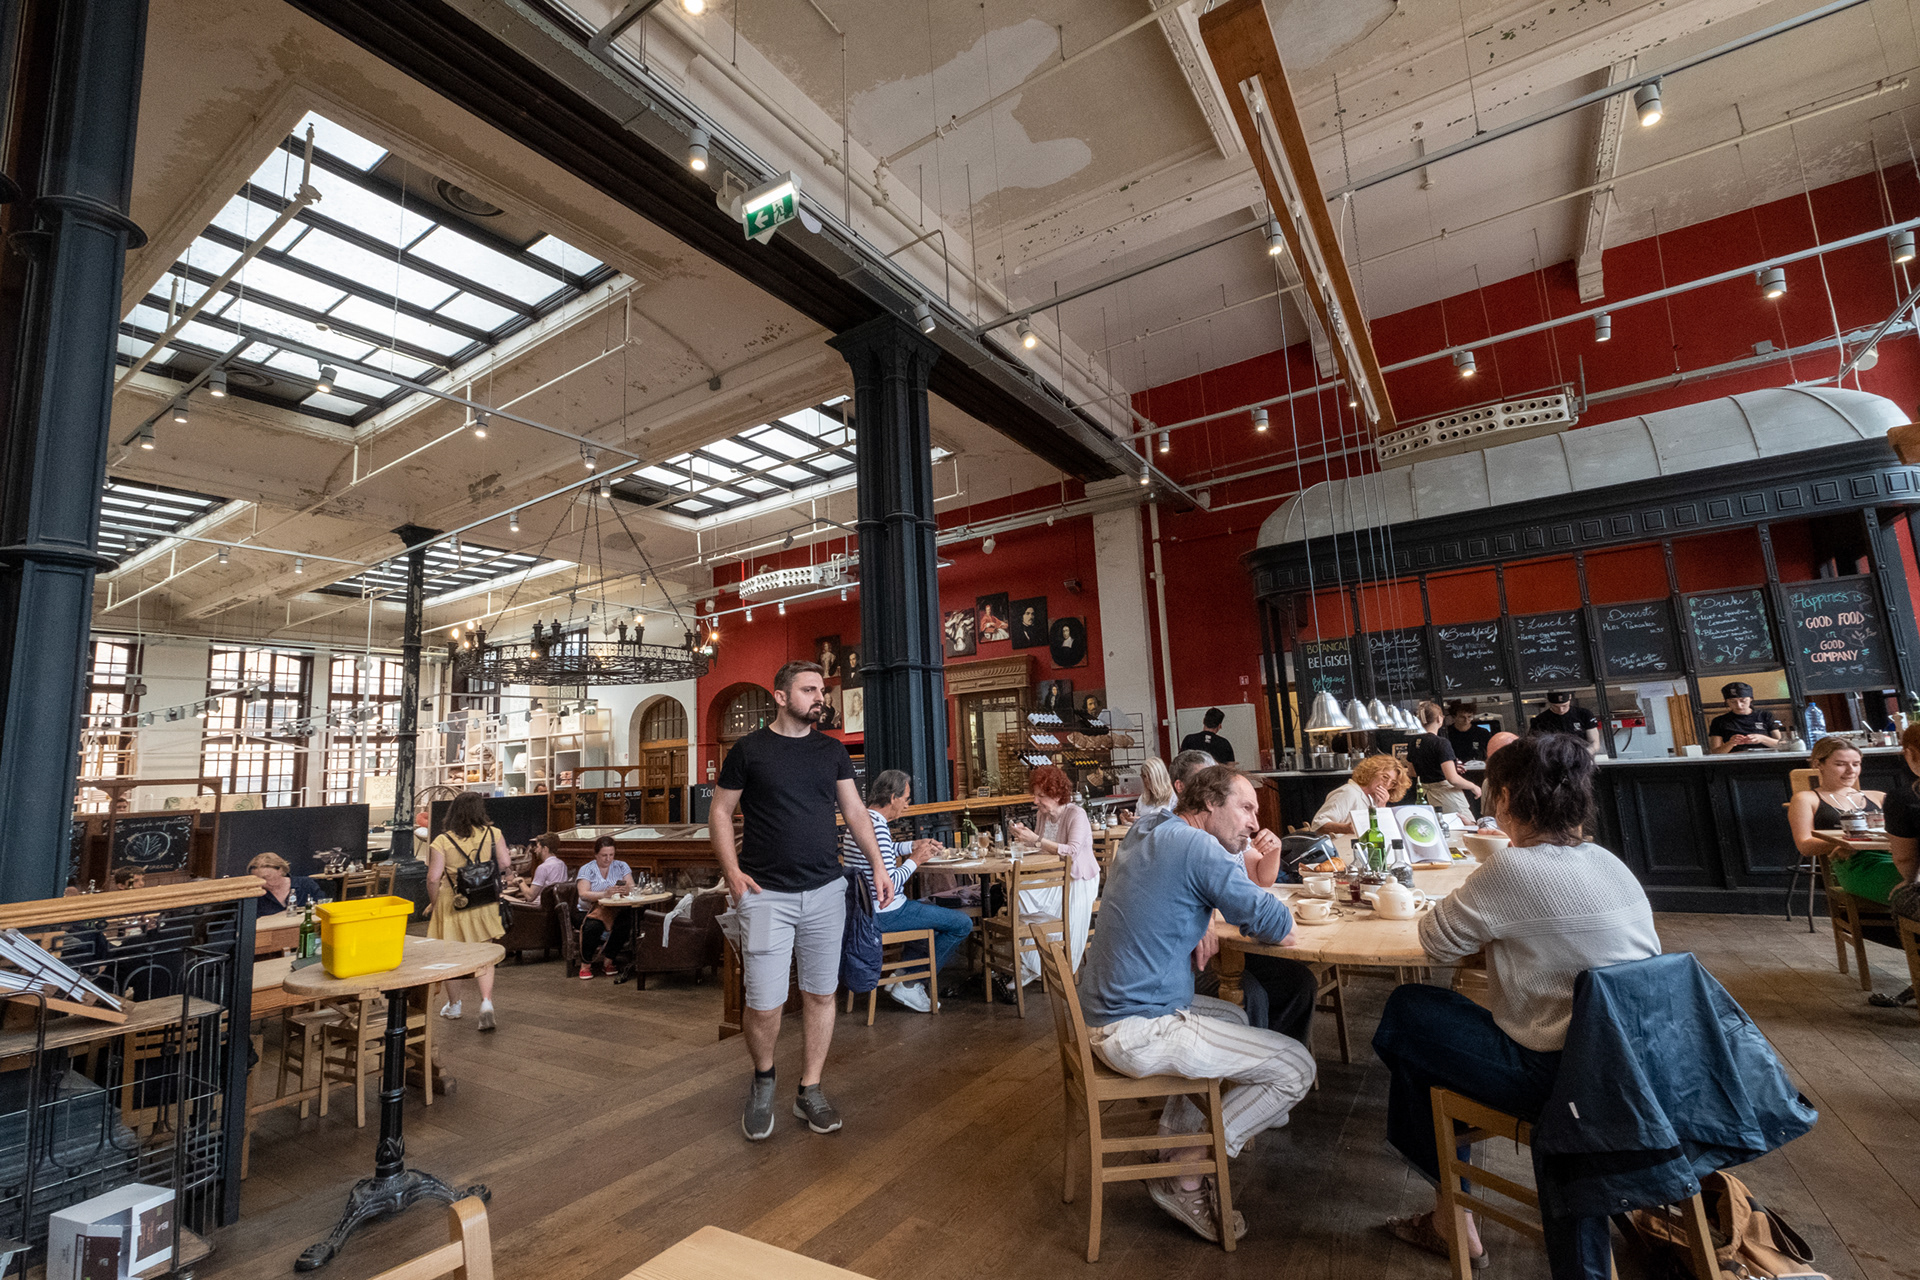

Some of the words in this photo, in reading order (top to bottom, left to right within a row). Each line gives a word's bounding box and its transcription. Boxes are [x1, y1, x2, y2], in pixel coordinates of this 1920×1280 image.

[1700, 595, 1748, 609] Drinks
[1794, 591, 1848, 612] Happiness
[1853, 594, 1862, 602] is
[1607, 606, 1659, 621] Desserts
[1805, 615, 1833, 629] GOOD
[1837, 611, 1865, 626] FOOD
[1527, 617, 1567, 629] Lunch
[1306, 641, 1350, 654] BOTANICAL
[1820, 639, 1845, 651] GOOD
[1307, 654, 1350, 669] BELGISCH
[1810, 650, 1858, 663] COMPANY
